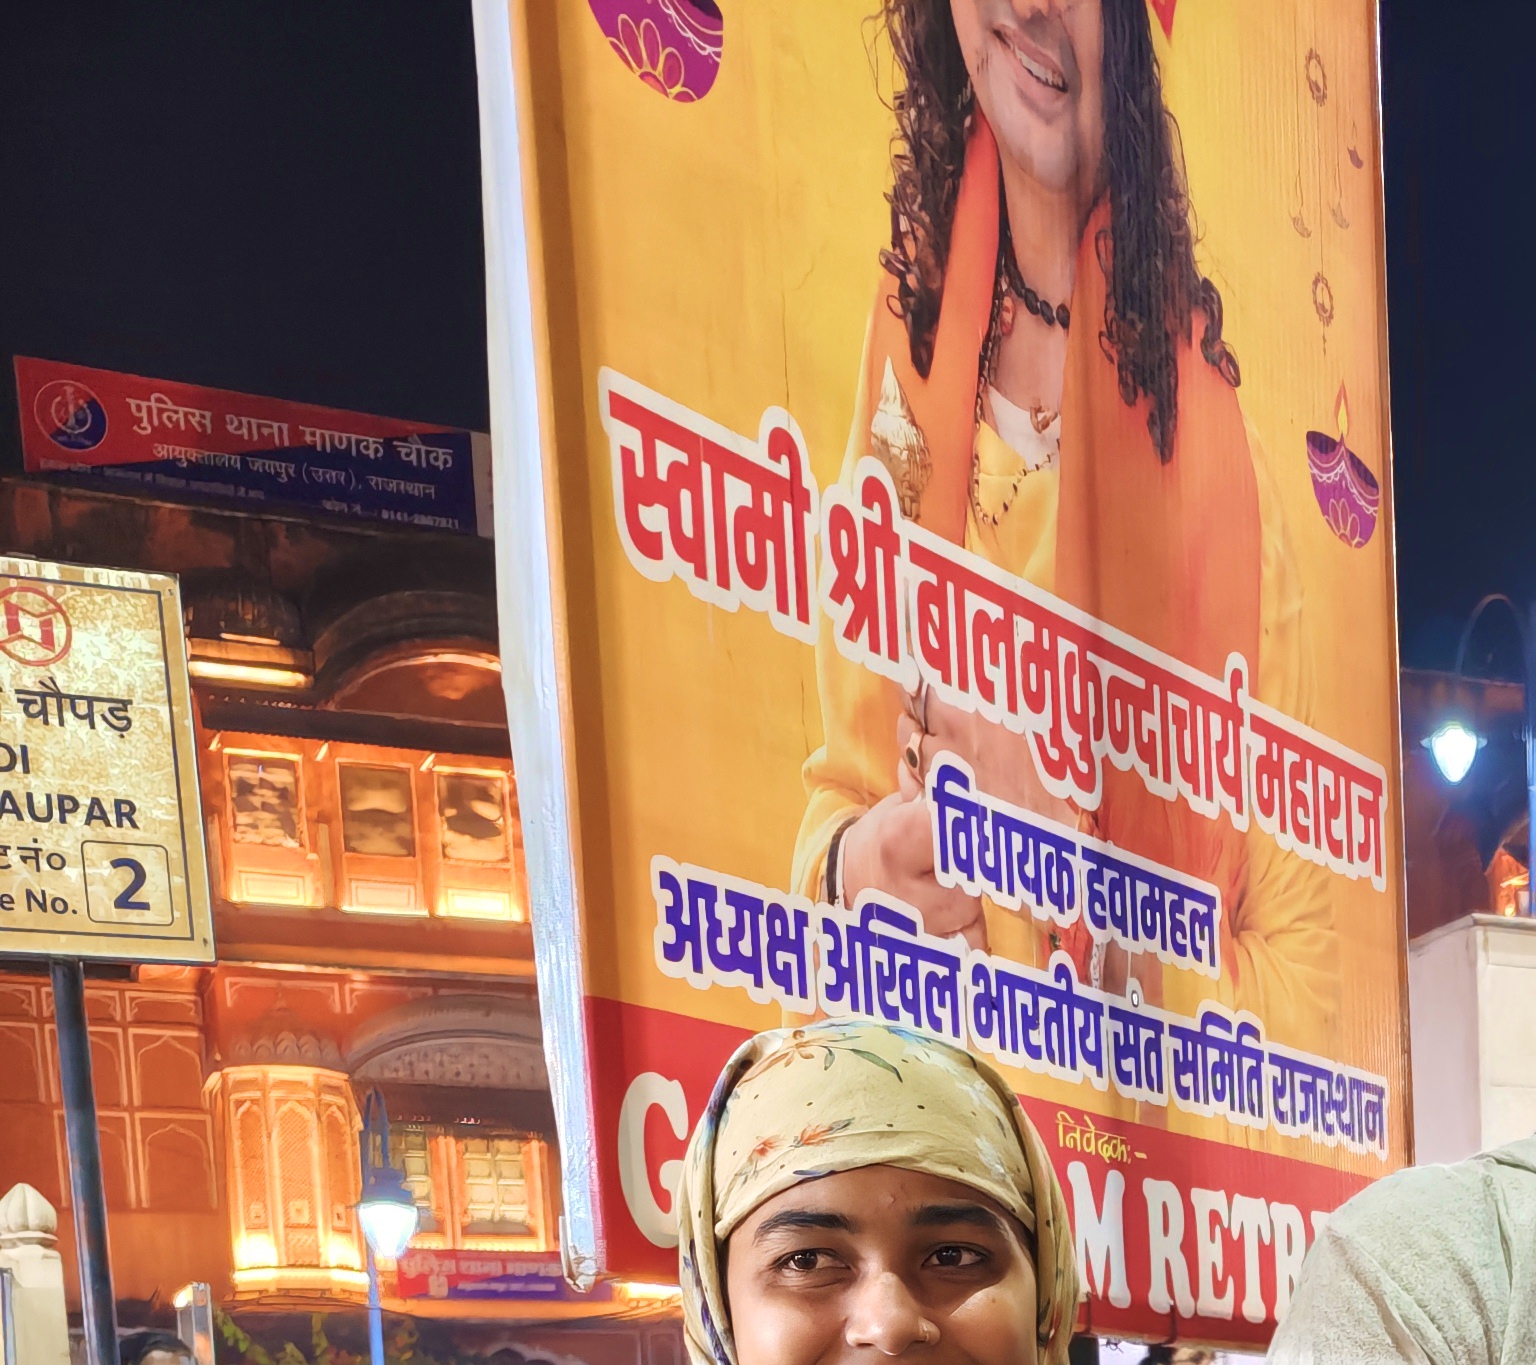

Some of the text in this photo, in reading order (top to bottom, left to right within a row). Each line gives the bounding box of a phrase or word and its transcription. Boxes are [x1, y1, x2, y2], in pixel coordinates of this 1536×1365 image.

[126, 392, 453, 472] पुलिस थाना माणक चौक
[608, 390, 1386, 880] स्वामी श्री बालमुकुन्दाचार्य महाराज
[14, 676, 134, 739] चौपड़
[25, 888, 78, 915] No.
[109, 857, 152, 912] 2
[931, 764, 1219, 971] विधायक हवामहल
[657, 868, 1388, 1152] अध्यक्ष अखिल भारतीय संत समिति राजस्थान
